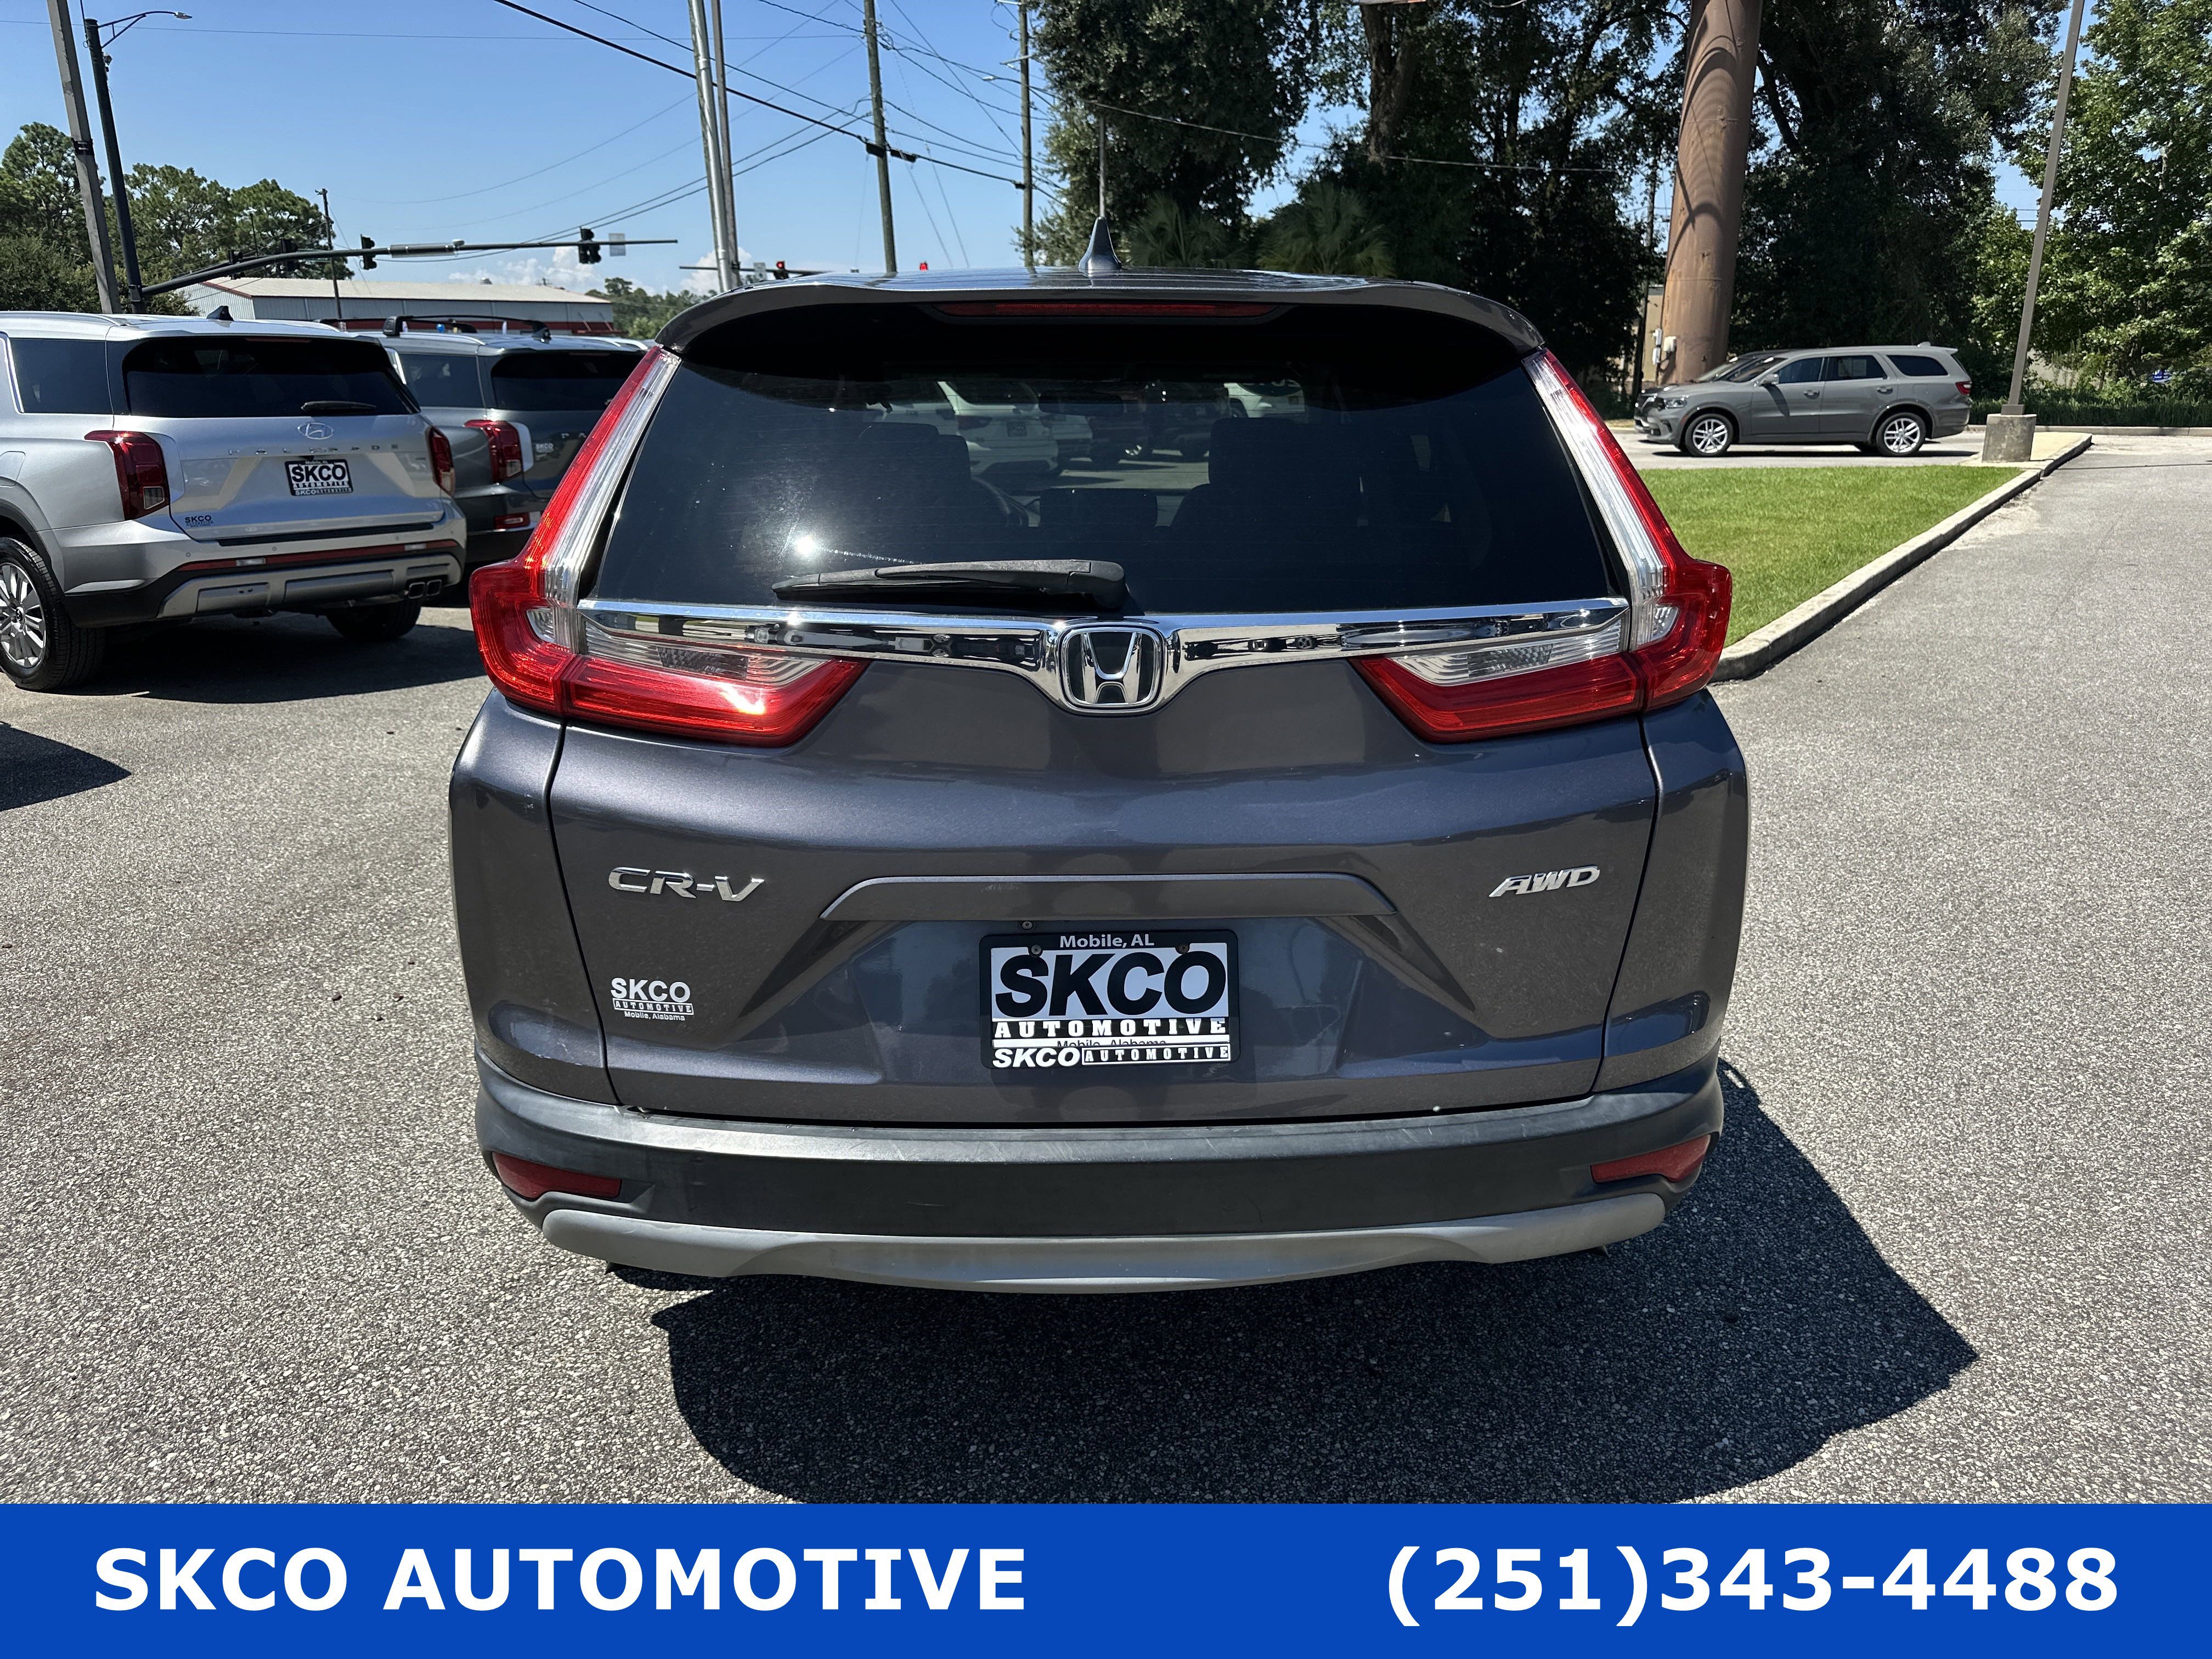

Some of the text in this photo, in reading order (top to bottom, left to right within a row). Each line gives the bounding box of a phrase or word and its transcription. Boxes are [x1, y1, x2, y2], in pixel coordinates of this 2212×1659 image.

[291, 464, 346, 483] SKCO
[184, 515, 212, 523] SKCO
[608, 867, 765, 902] CR-V
[1488, 865, 1600, 898] AWD
[1060, 934, 1155, 949] Mobile, AL
[610, 978, 691, 1003] SKCO
[995, 951, 1227, 1018] SKCO
[615, 1001, 692, 1013] AUTOMOTIVE
[652, 1013, 685, 1022] Alabama
[994, 1018, 1226, 1039] AUTOMOTIVE
[992, 1046, 1229, 1068] SKCO AUTOMOTIVE
